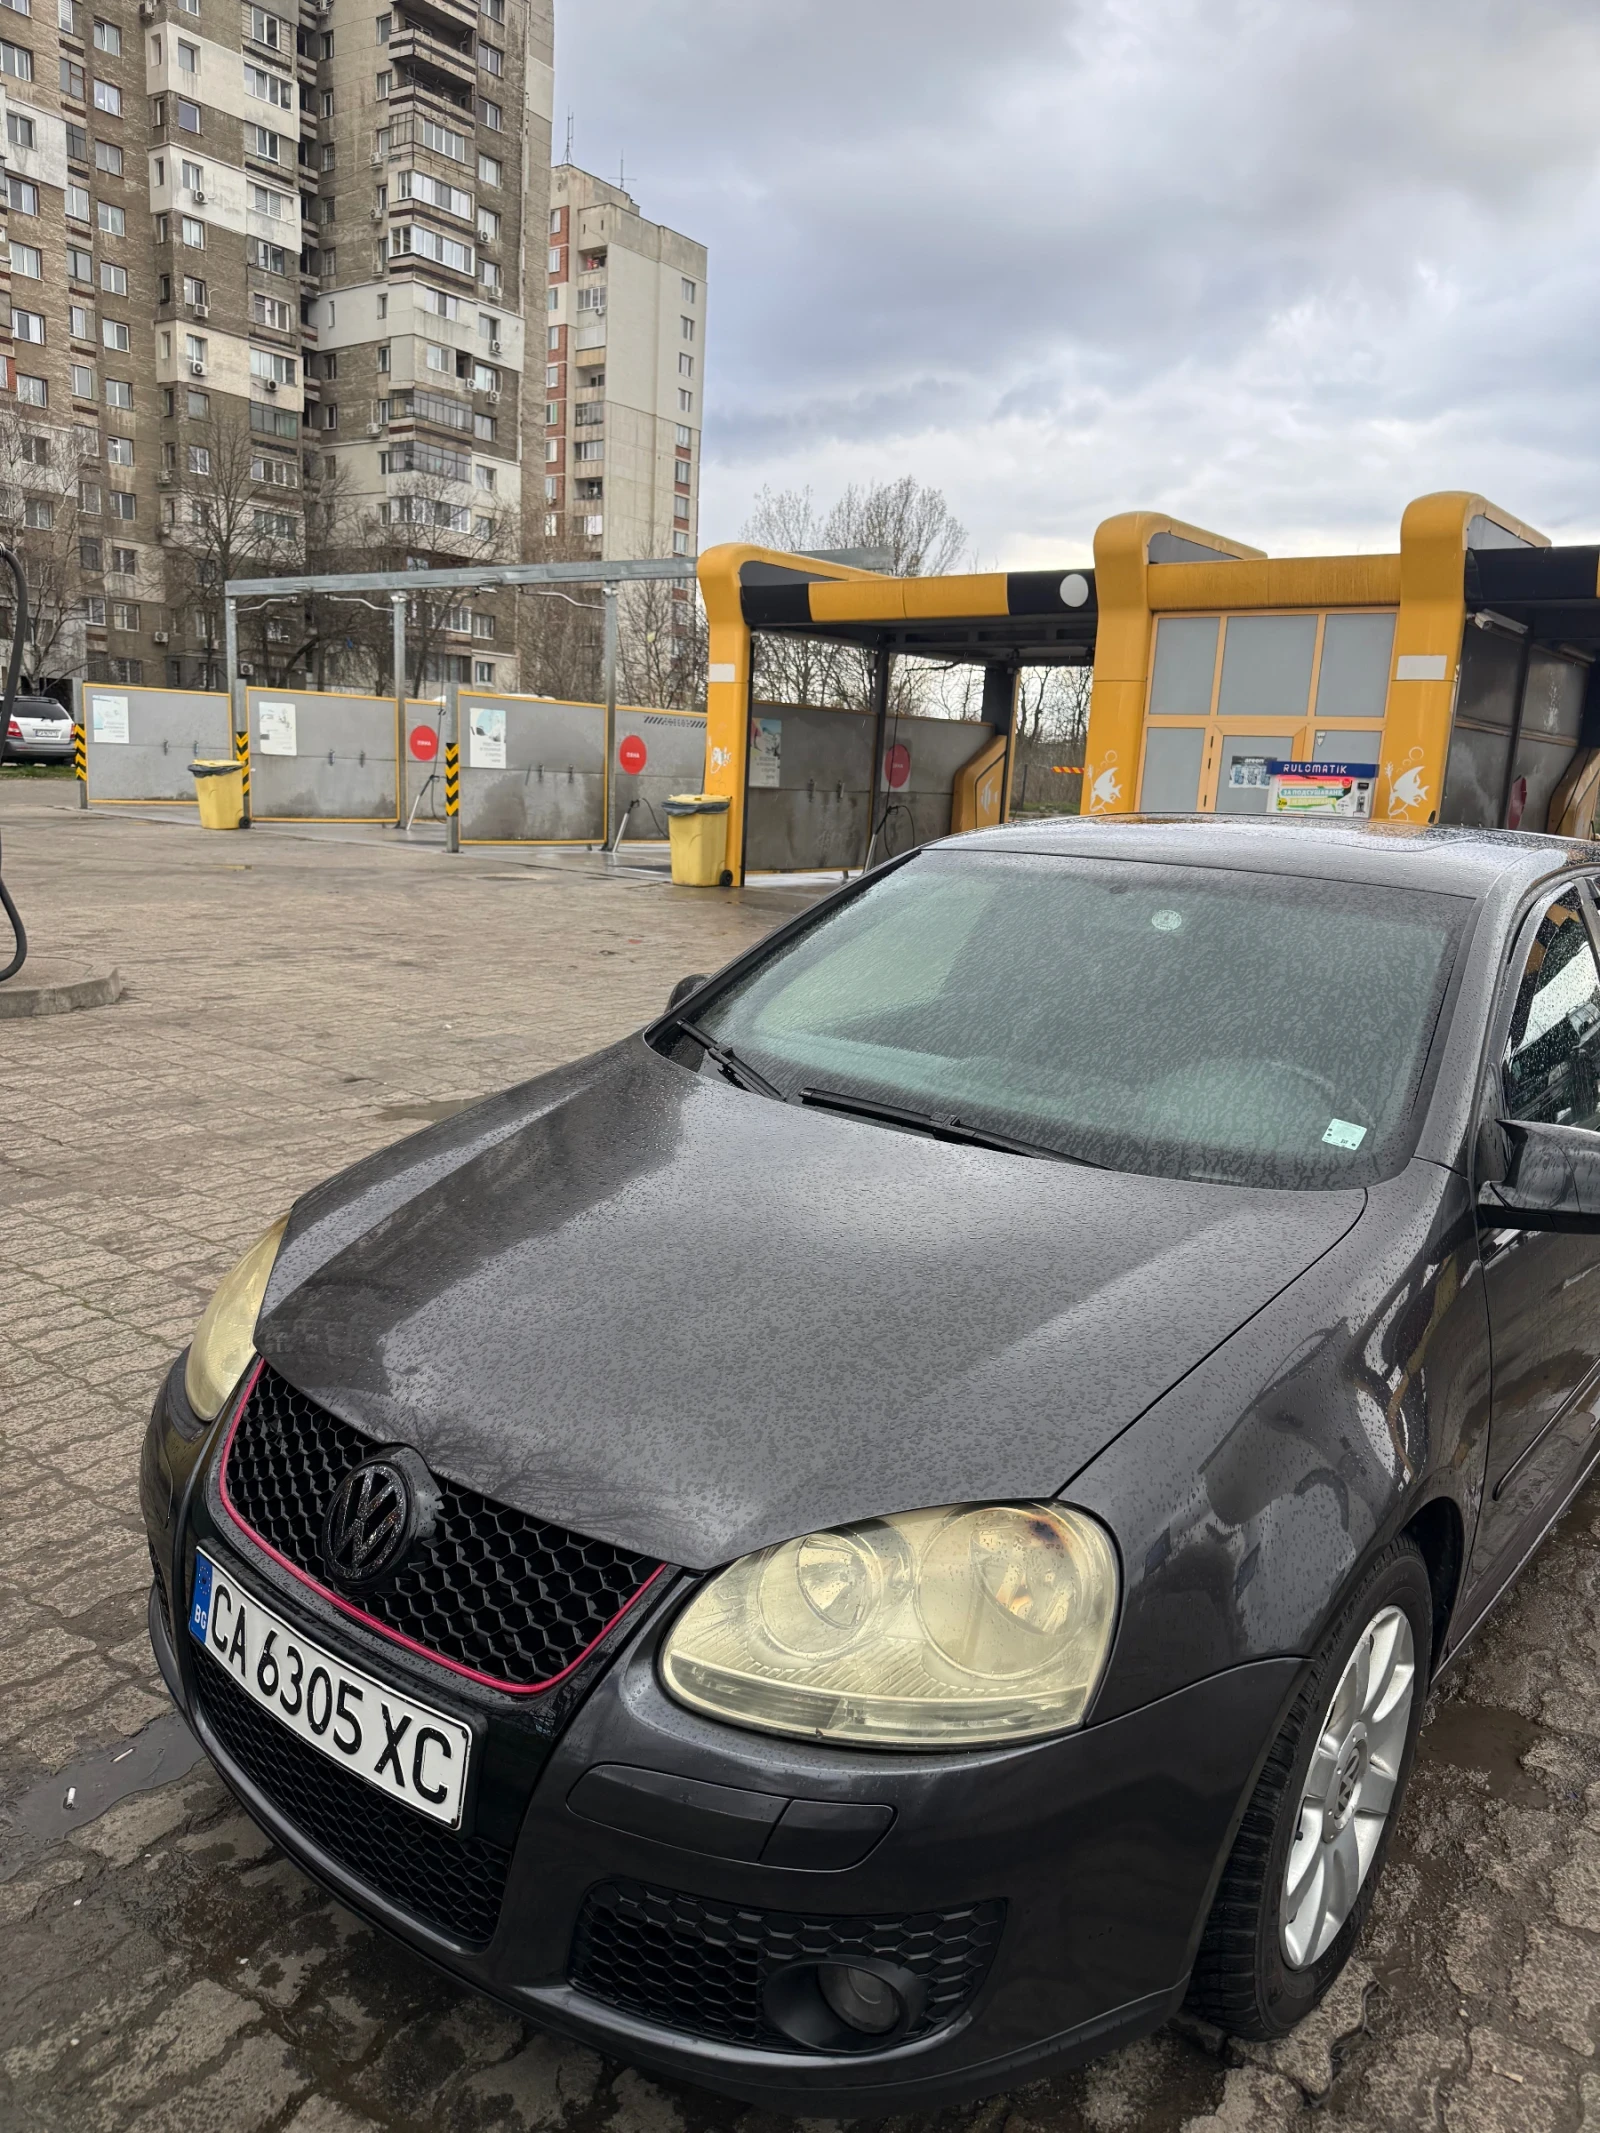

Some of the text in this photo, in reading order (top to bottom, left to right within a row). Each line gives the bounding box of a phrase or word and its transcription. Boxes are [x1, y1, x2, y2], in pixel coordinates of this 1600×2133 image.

[1283, 763, 1348, 774] RULOMATIK
[194, 1603, 208, 1630] BG
[212, 1583, 452, 1805] CA 6305 XC
